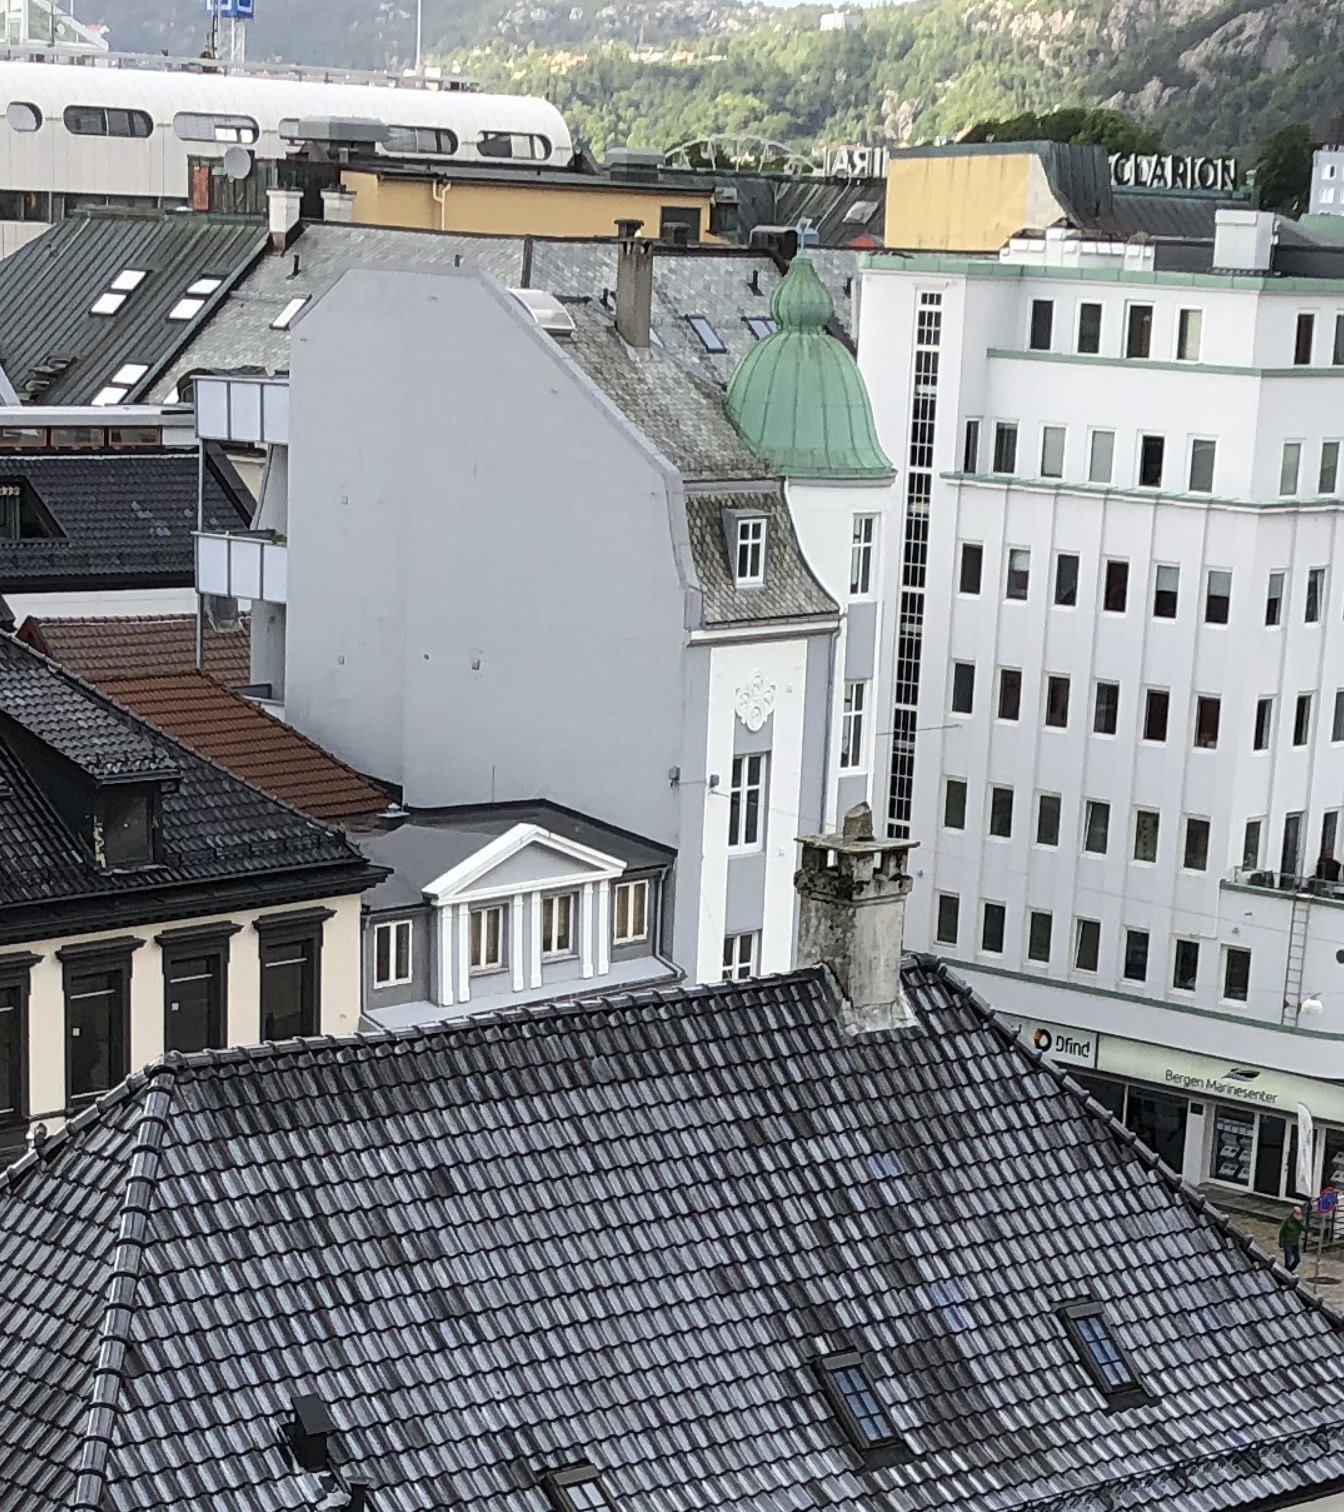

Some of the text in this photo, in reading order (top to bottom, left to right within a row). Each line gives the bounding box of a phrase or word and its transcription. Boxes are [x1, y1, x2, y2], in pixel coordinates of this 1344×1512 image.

[1109, 153, 1238, 191] CLARION
[1165, 1069, 1278, 1103] Bergen Marinesenter
